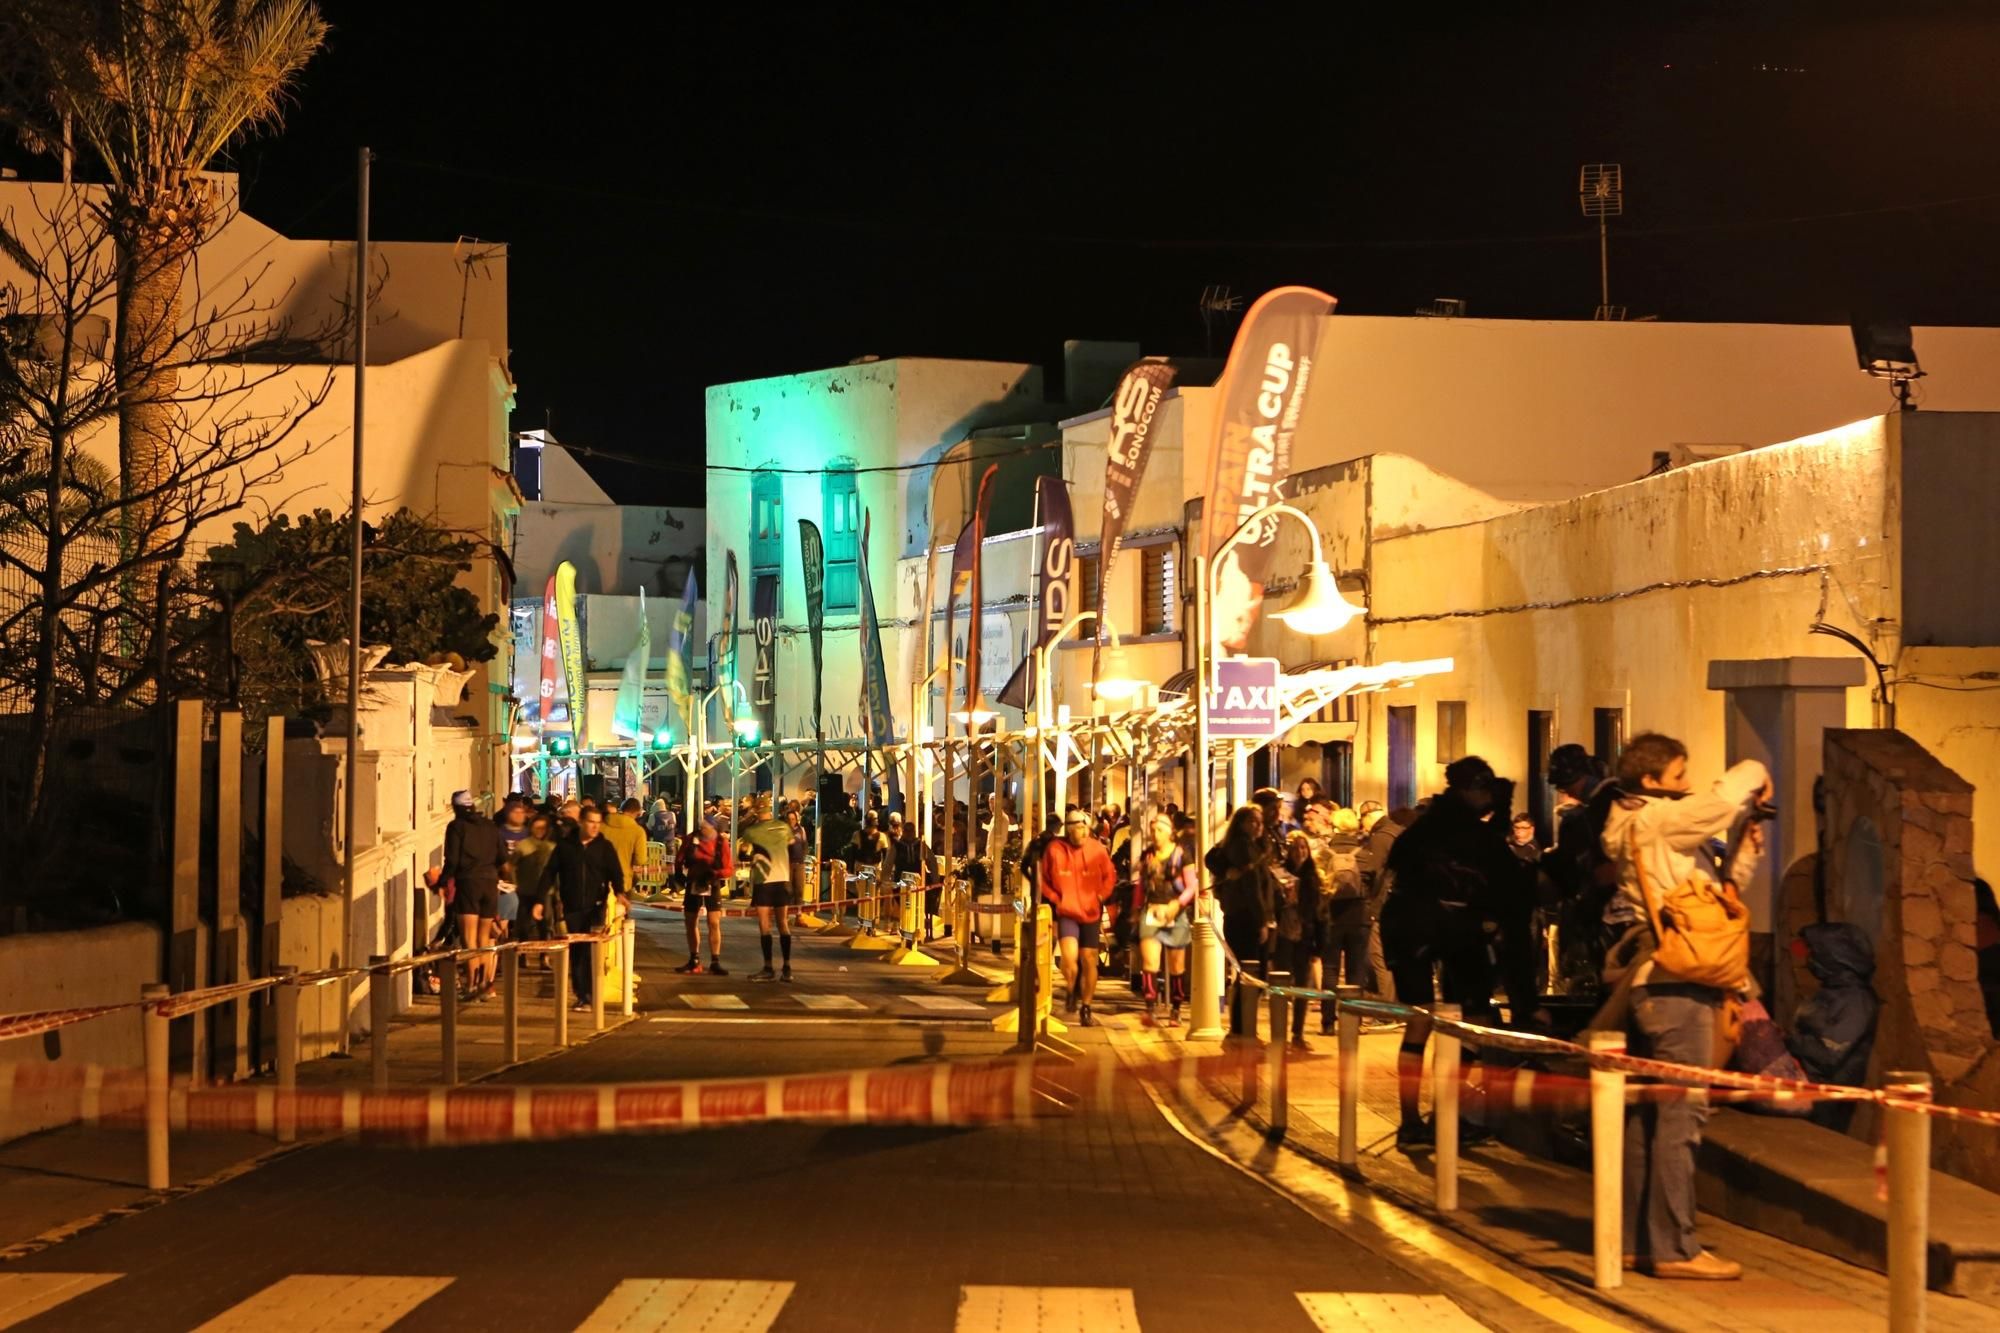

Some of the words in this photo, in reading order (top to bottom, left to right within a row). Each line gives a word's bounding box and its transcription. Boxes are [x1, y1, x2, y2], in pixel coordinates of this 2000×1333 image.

[1125, 386, 1162, 470] SONOCOM
[1236, 425, 1277, 545] ULTRA
[1257, 342, 1294, 419] CUP
[1211, 421, 1252, 538] SPAIN
[1206, 686, 1275, 710] TAXI
